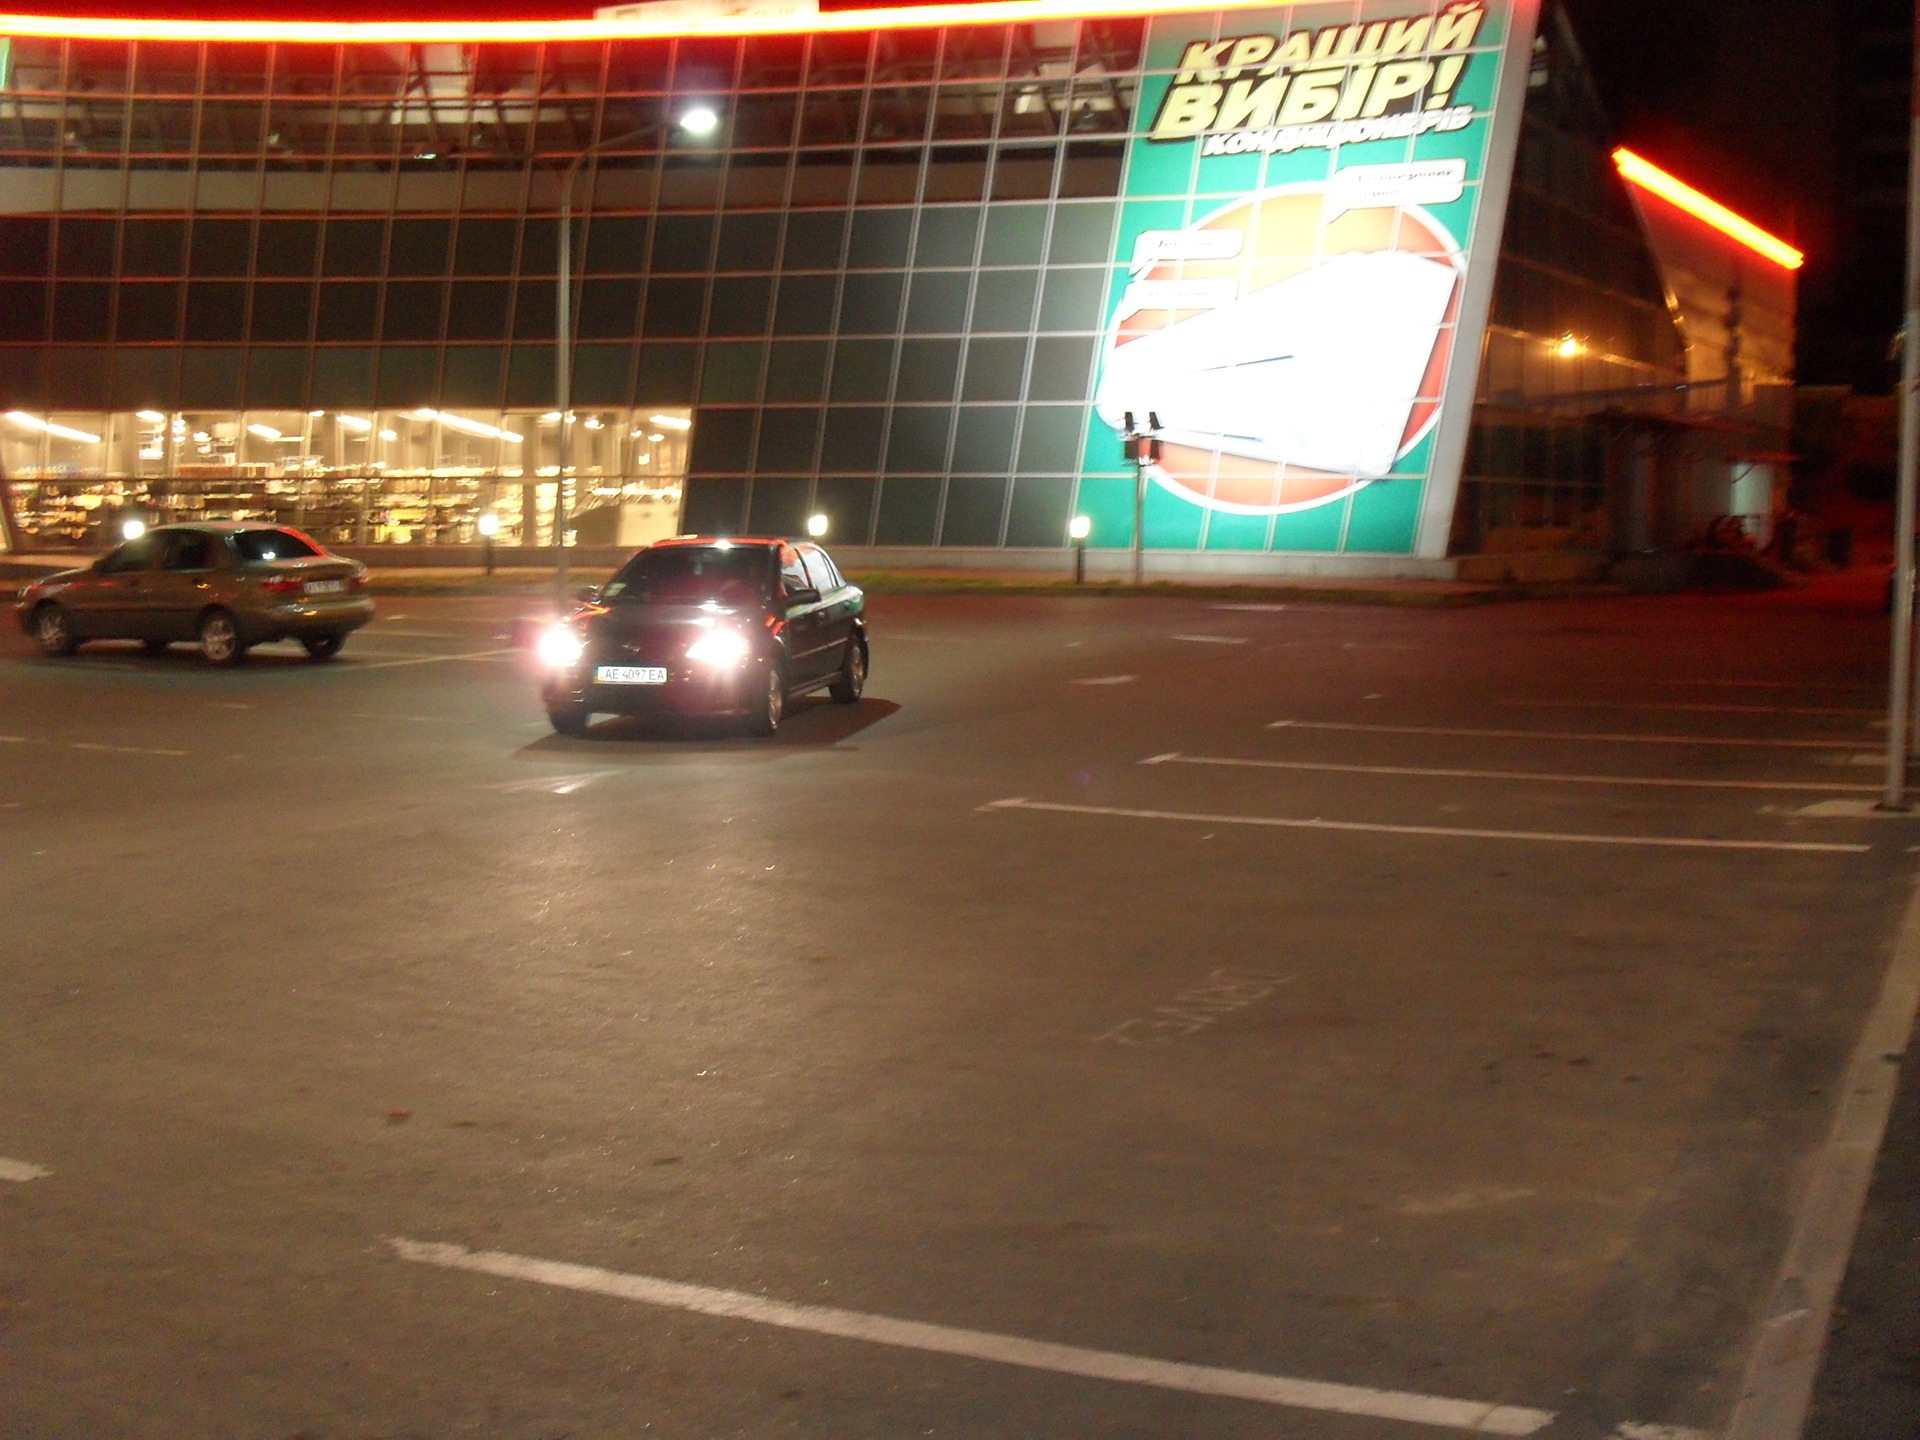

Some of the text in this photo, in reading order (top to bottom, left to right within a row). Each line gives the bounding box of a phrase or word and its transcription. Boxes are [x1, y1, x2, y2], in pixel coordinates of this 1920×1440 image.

[1174, 3, 1484, 84] КРАЩИЙ
[1152, 54, 1470, 140] ВИБІР!
[605, 668, 665, 681] AE 4097 EA
